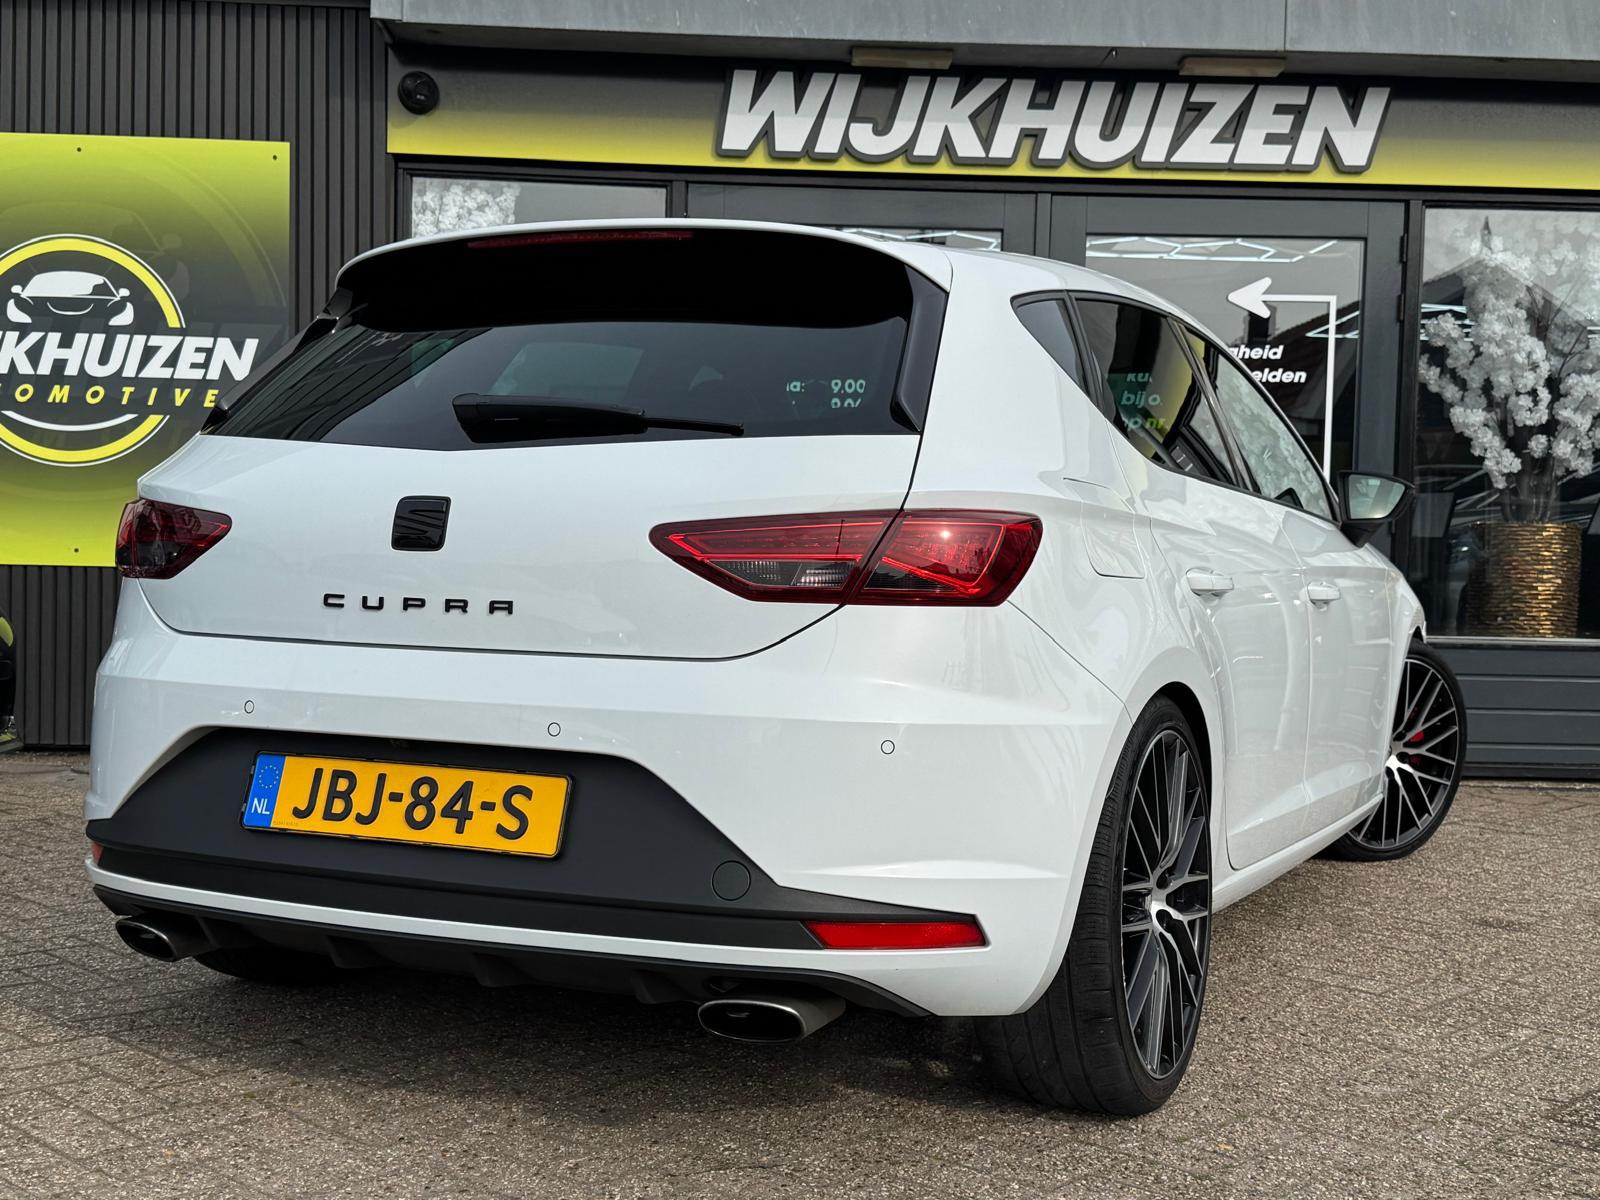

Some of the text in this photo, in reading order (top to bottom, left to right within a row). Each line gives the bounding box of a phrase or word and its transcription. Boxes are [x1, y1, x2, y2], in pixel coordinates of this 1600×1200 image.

[718, 68, 1392, 170] WIJKHUIZEN
[0, 330, 259, 381] KHUIZEN
[0, 383, 219, 408] OMOTIVE
[830, 379, 866, 394] 9.00
[322, 592, 514, 615] CUPRA
[251, 797, 270, 815] NL
[291, 767, 534, 840] JBJ-84-S
